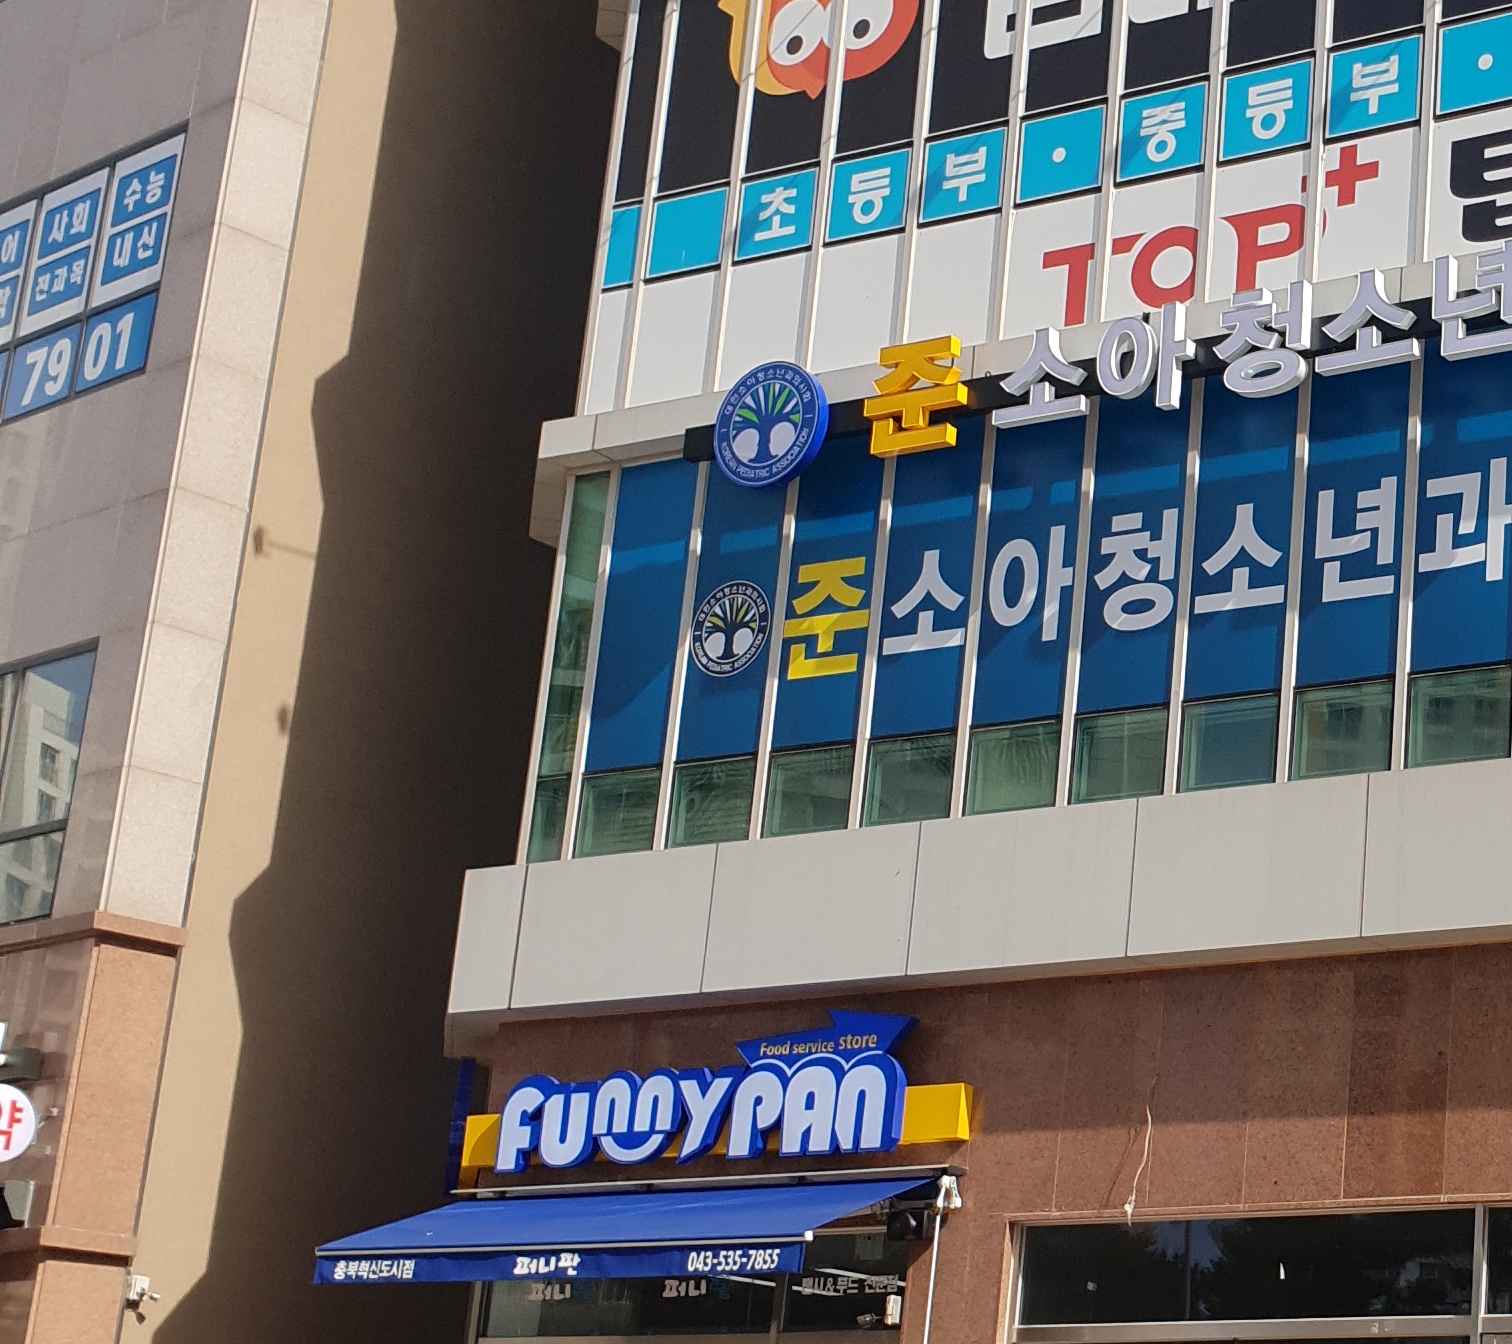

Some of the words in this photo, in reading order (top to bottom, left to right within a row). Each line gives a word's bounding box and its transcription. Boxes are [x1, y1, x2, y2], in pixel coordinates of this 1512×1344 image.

[754, 146, 988, 241] 초등부
[1140, 53, 1401, 163] 중등부
[47, 198, 92, 244] 사회
[112, 222, 158, 268] 내신
[864, 333, 968, 458] 준
[783, 556, 870, 681] 준
[759, 1041, 790, 1057] Food
[791, 1039, 835, 1055] service
[838, 1033, 878, 1051] store
[333, 1258, 416, 1281] 충북혁신도시점
[512, 1251, 582, 1277] 퍼니판
[687, 1248, 781, 1273] 043-535-7855
